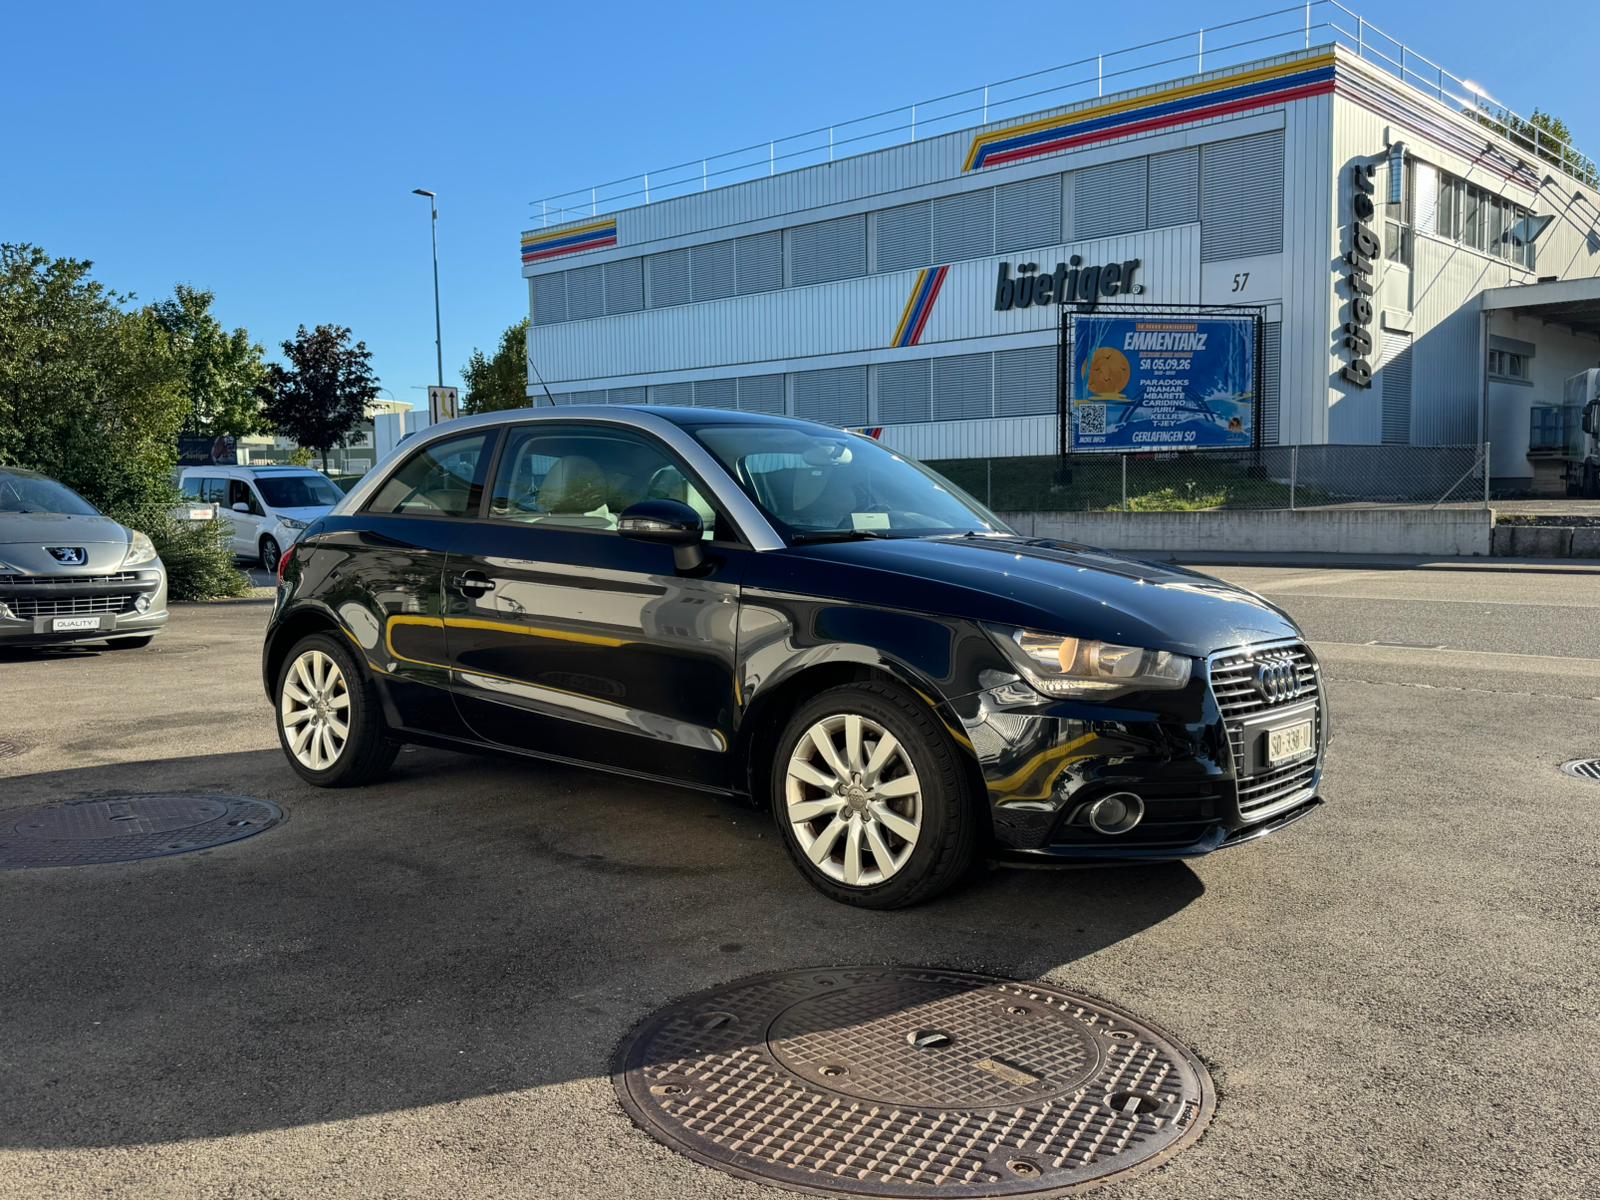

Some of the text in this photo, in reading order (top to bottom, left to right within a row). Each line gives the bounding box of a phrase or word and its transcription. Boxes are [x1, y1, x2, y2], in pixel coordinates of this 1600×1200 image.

[1232, 272, 1250, 293] 57
[1123, 332, 1208, 351] EMMENTANZ
[1140, 359, 1191, 370] SA 05.09.26
[1132, 431, 1196, 443] GERLAFINGEN SO
